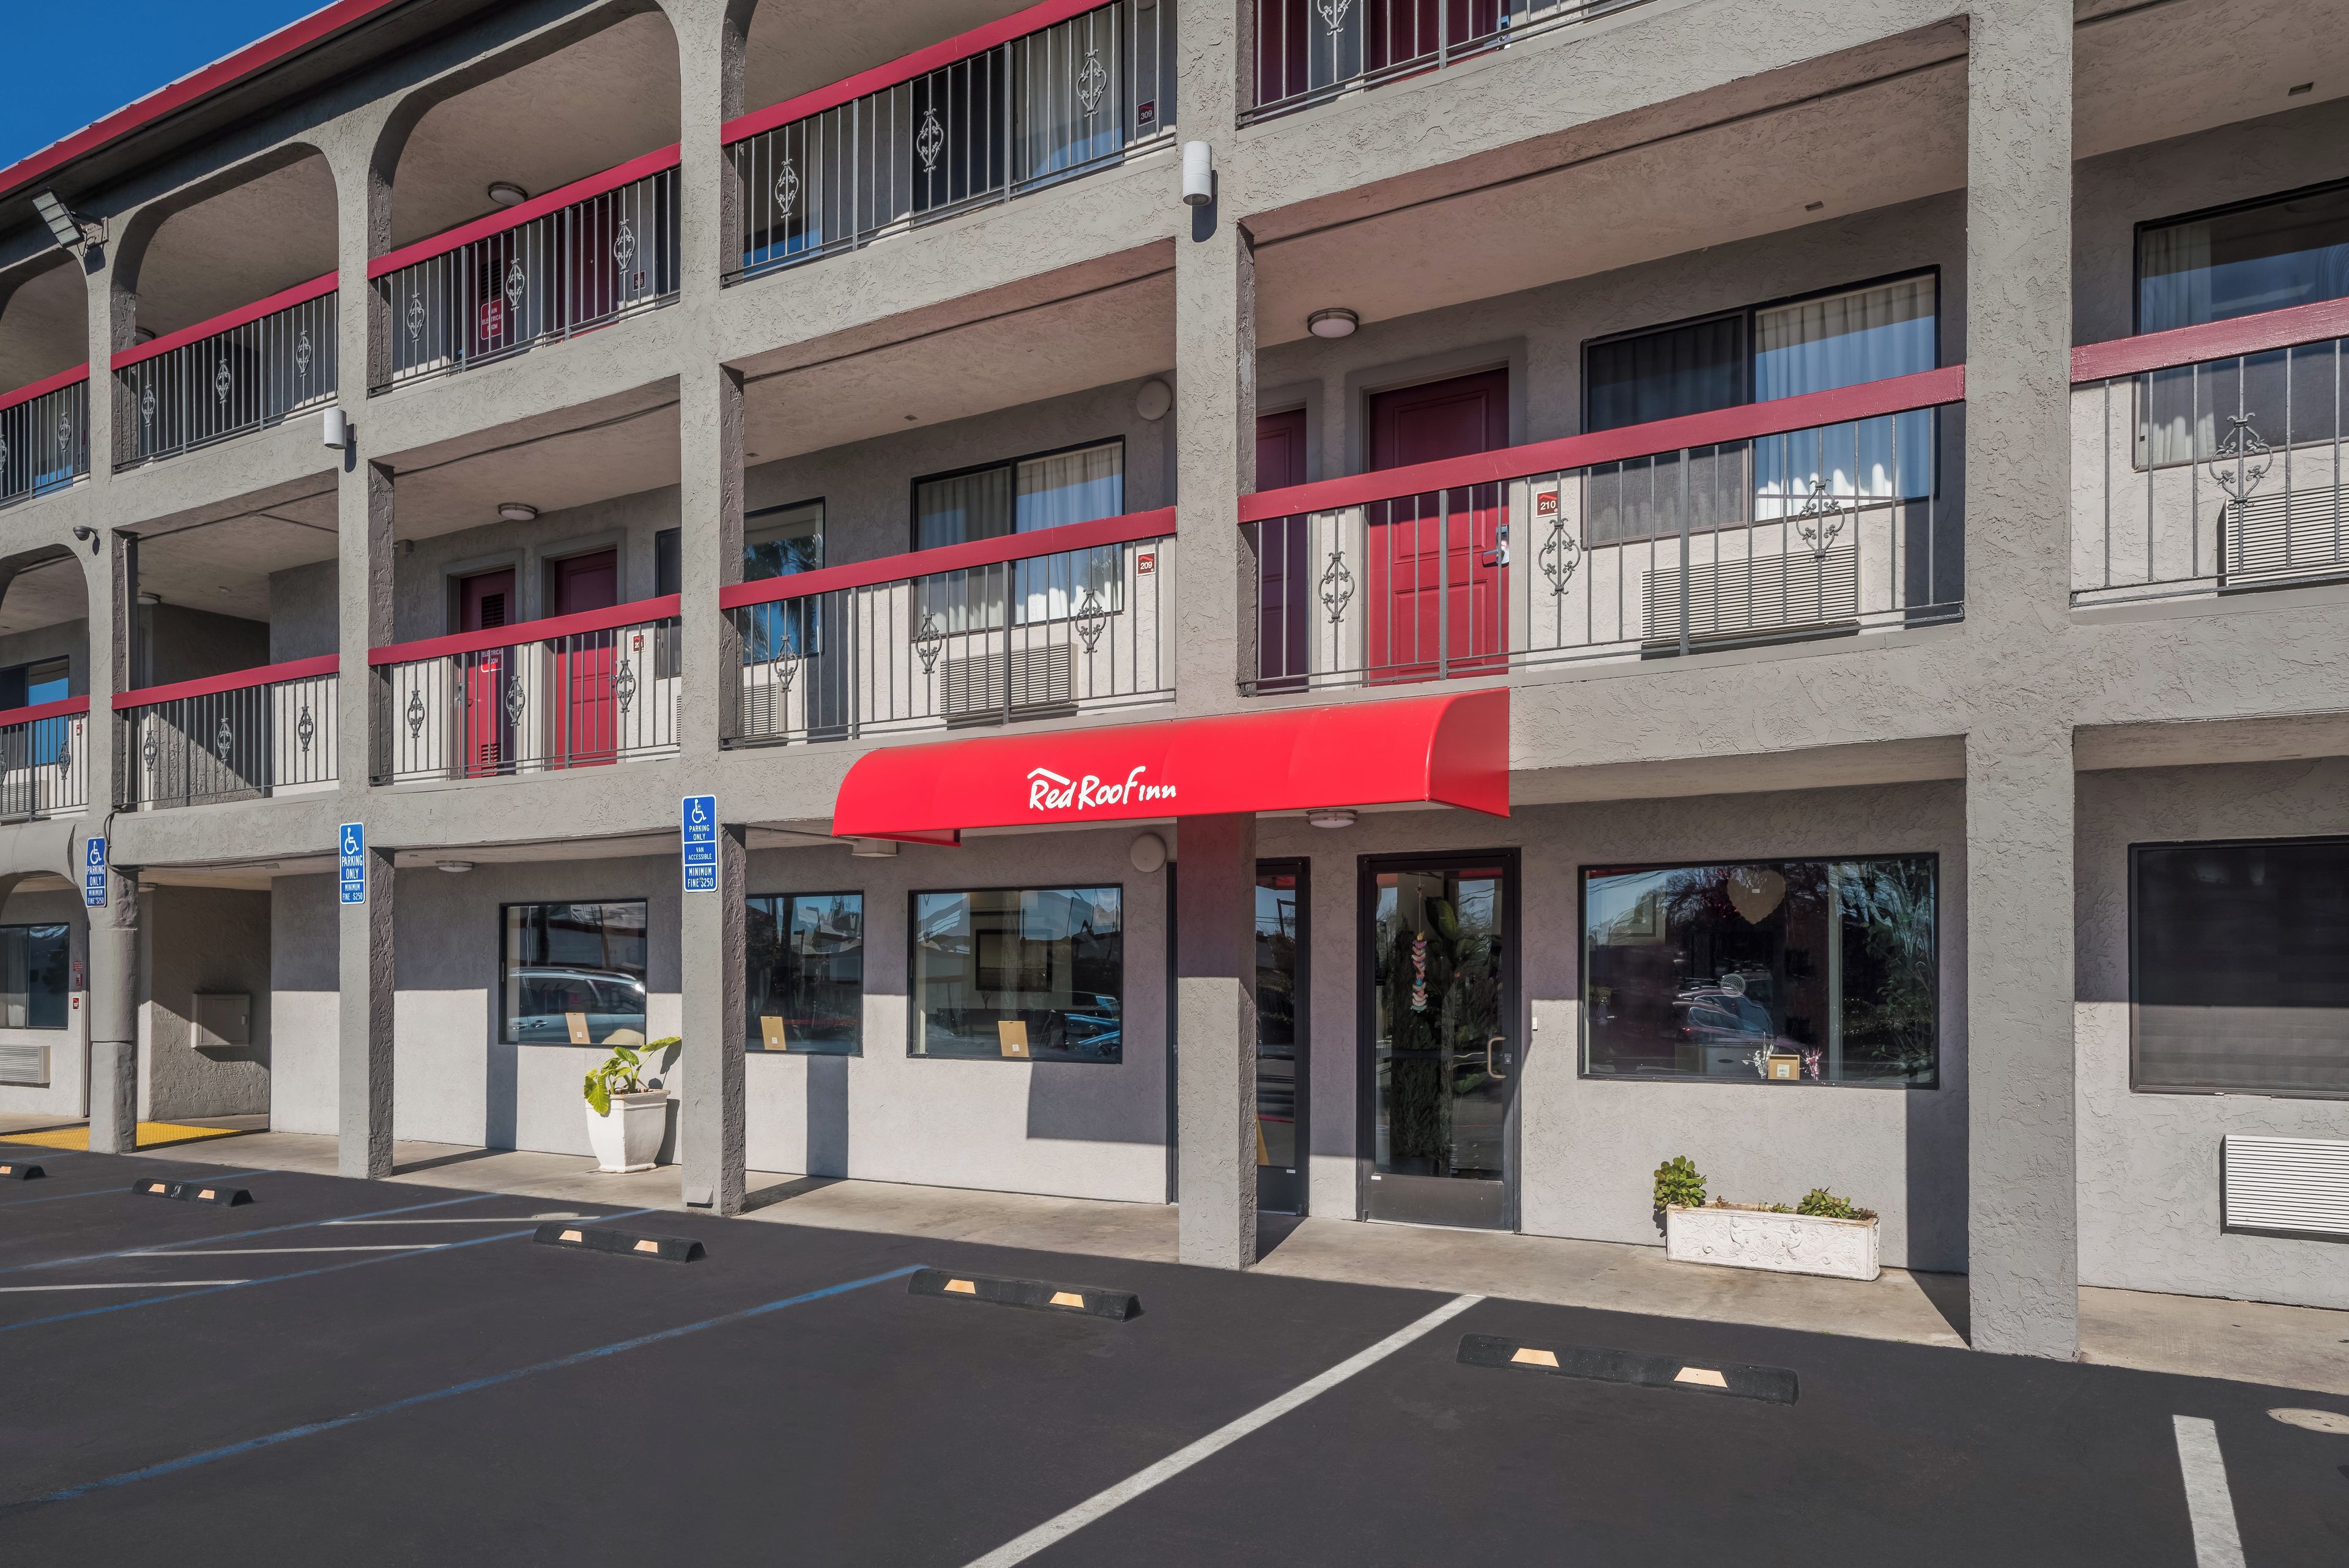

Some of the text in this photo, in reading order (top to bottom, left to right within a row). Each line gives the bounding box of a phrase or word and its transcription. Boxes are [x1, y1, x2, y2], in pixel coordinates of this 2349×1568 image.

[1140, 110, 1152, 120] 309
[482, 313, 502, 325] ELETRICA
[1540, 500, 1556, 510] 210
[1140, 561, 1152, 570] 209
[482, 649, 502, 658] ELETRICA
[1029, 779, 1077, 811] Red
[1078, 765, 1146, 810] Roof
[341, 855, 363, 867] PARKING
[87, 864, 105, 875] PARKING
[346, 868, 359, 879] ONLY
[689, 867, 712, 876] MINIMUM
[89, 876, 102, 886] ONLY
[688, 877, 714, 888] FINE $250
[352, 892, 363, 901] $250
